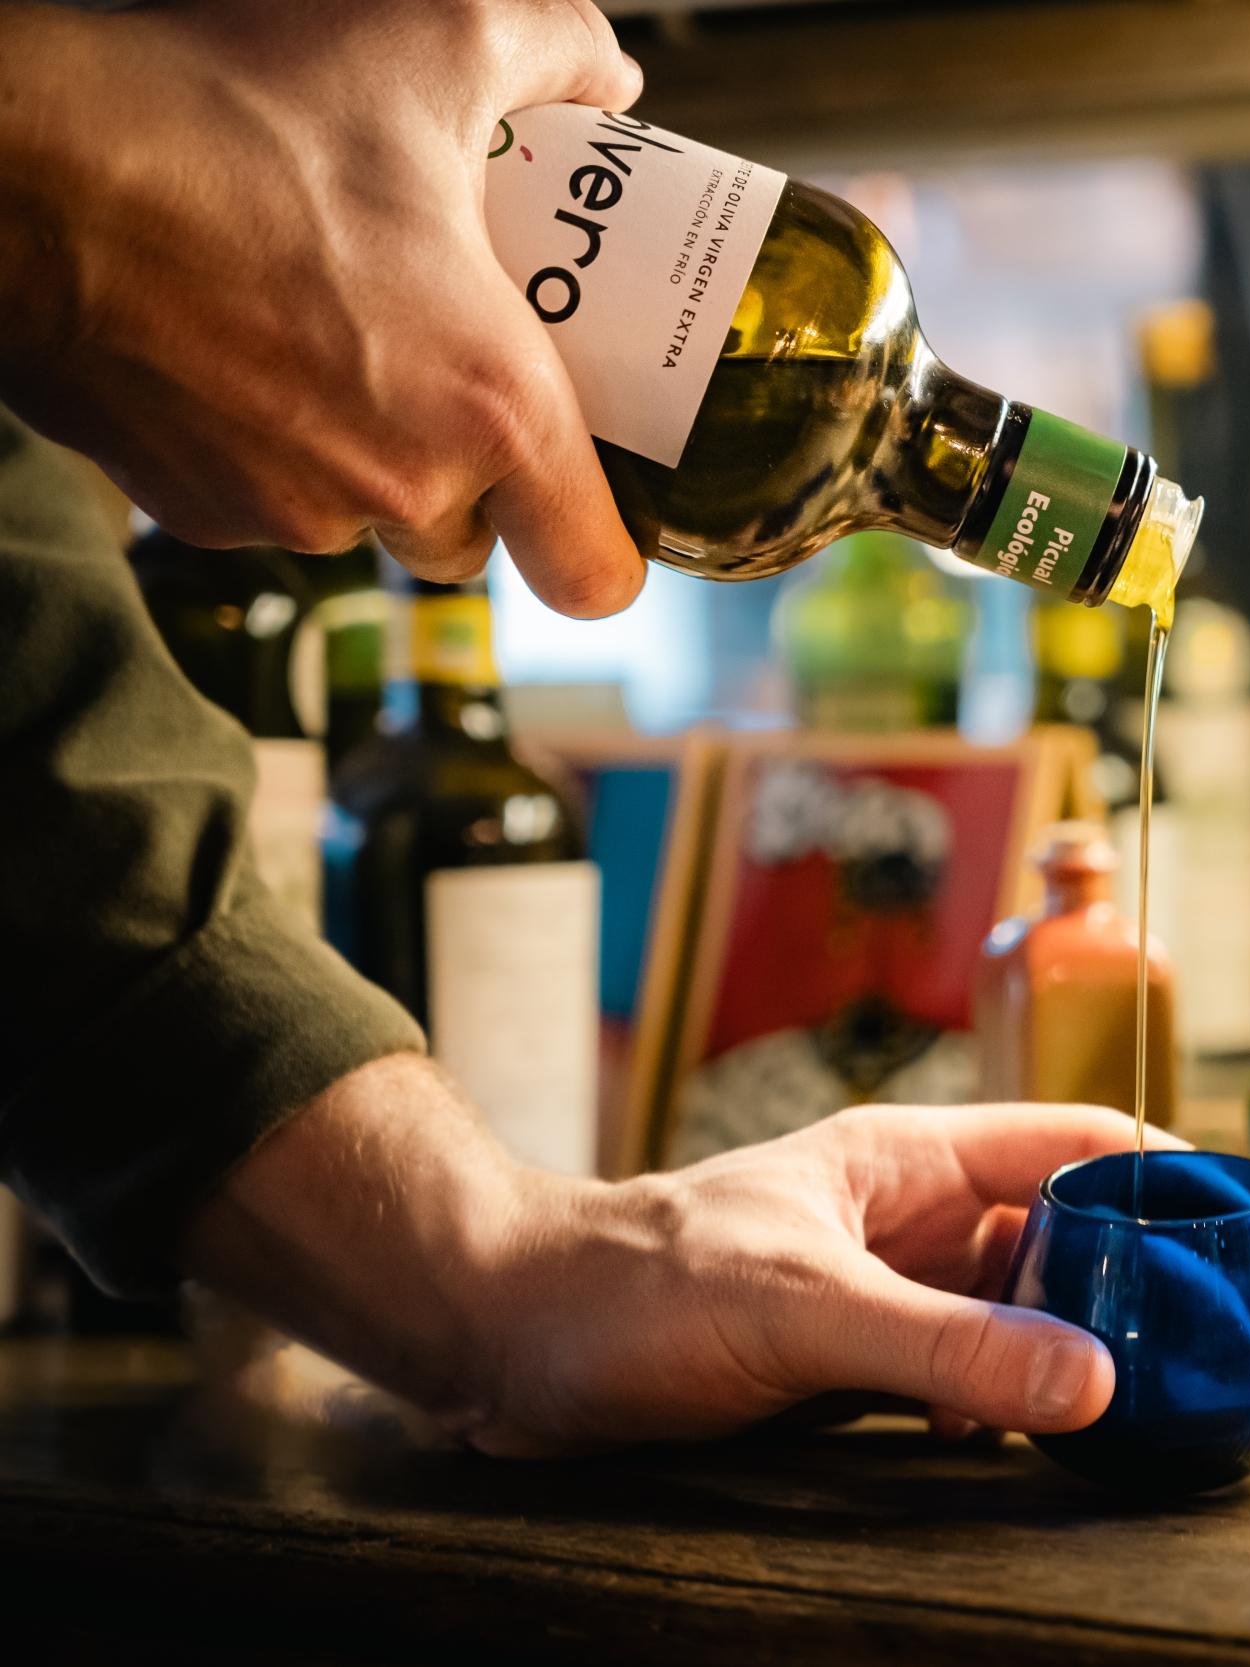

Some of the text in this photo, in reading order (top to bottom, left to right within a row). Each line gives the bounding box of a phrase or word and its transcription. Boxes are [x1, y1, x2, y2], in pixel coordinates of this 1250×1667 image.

[715, 192, 741, 232] OLIVA
[732, 176, 747, 191] DE
[670, 169, 723, 285] EXTRACCIÓN EN FRÍO
[688, 238, 724, 303] VIRGEN
[662, 309, 696, 368] EXTRA
[1032, 527, 1075, 585] Picual
